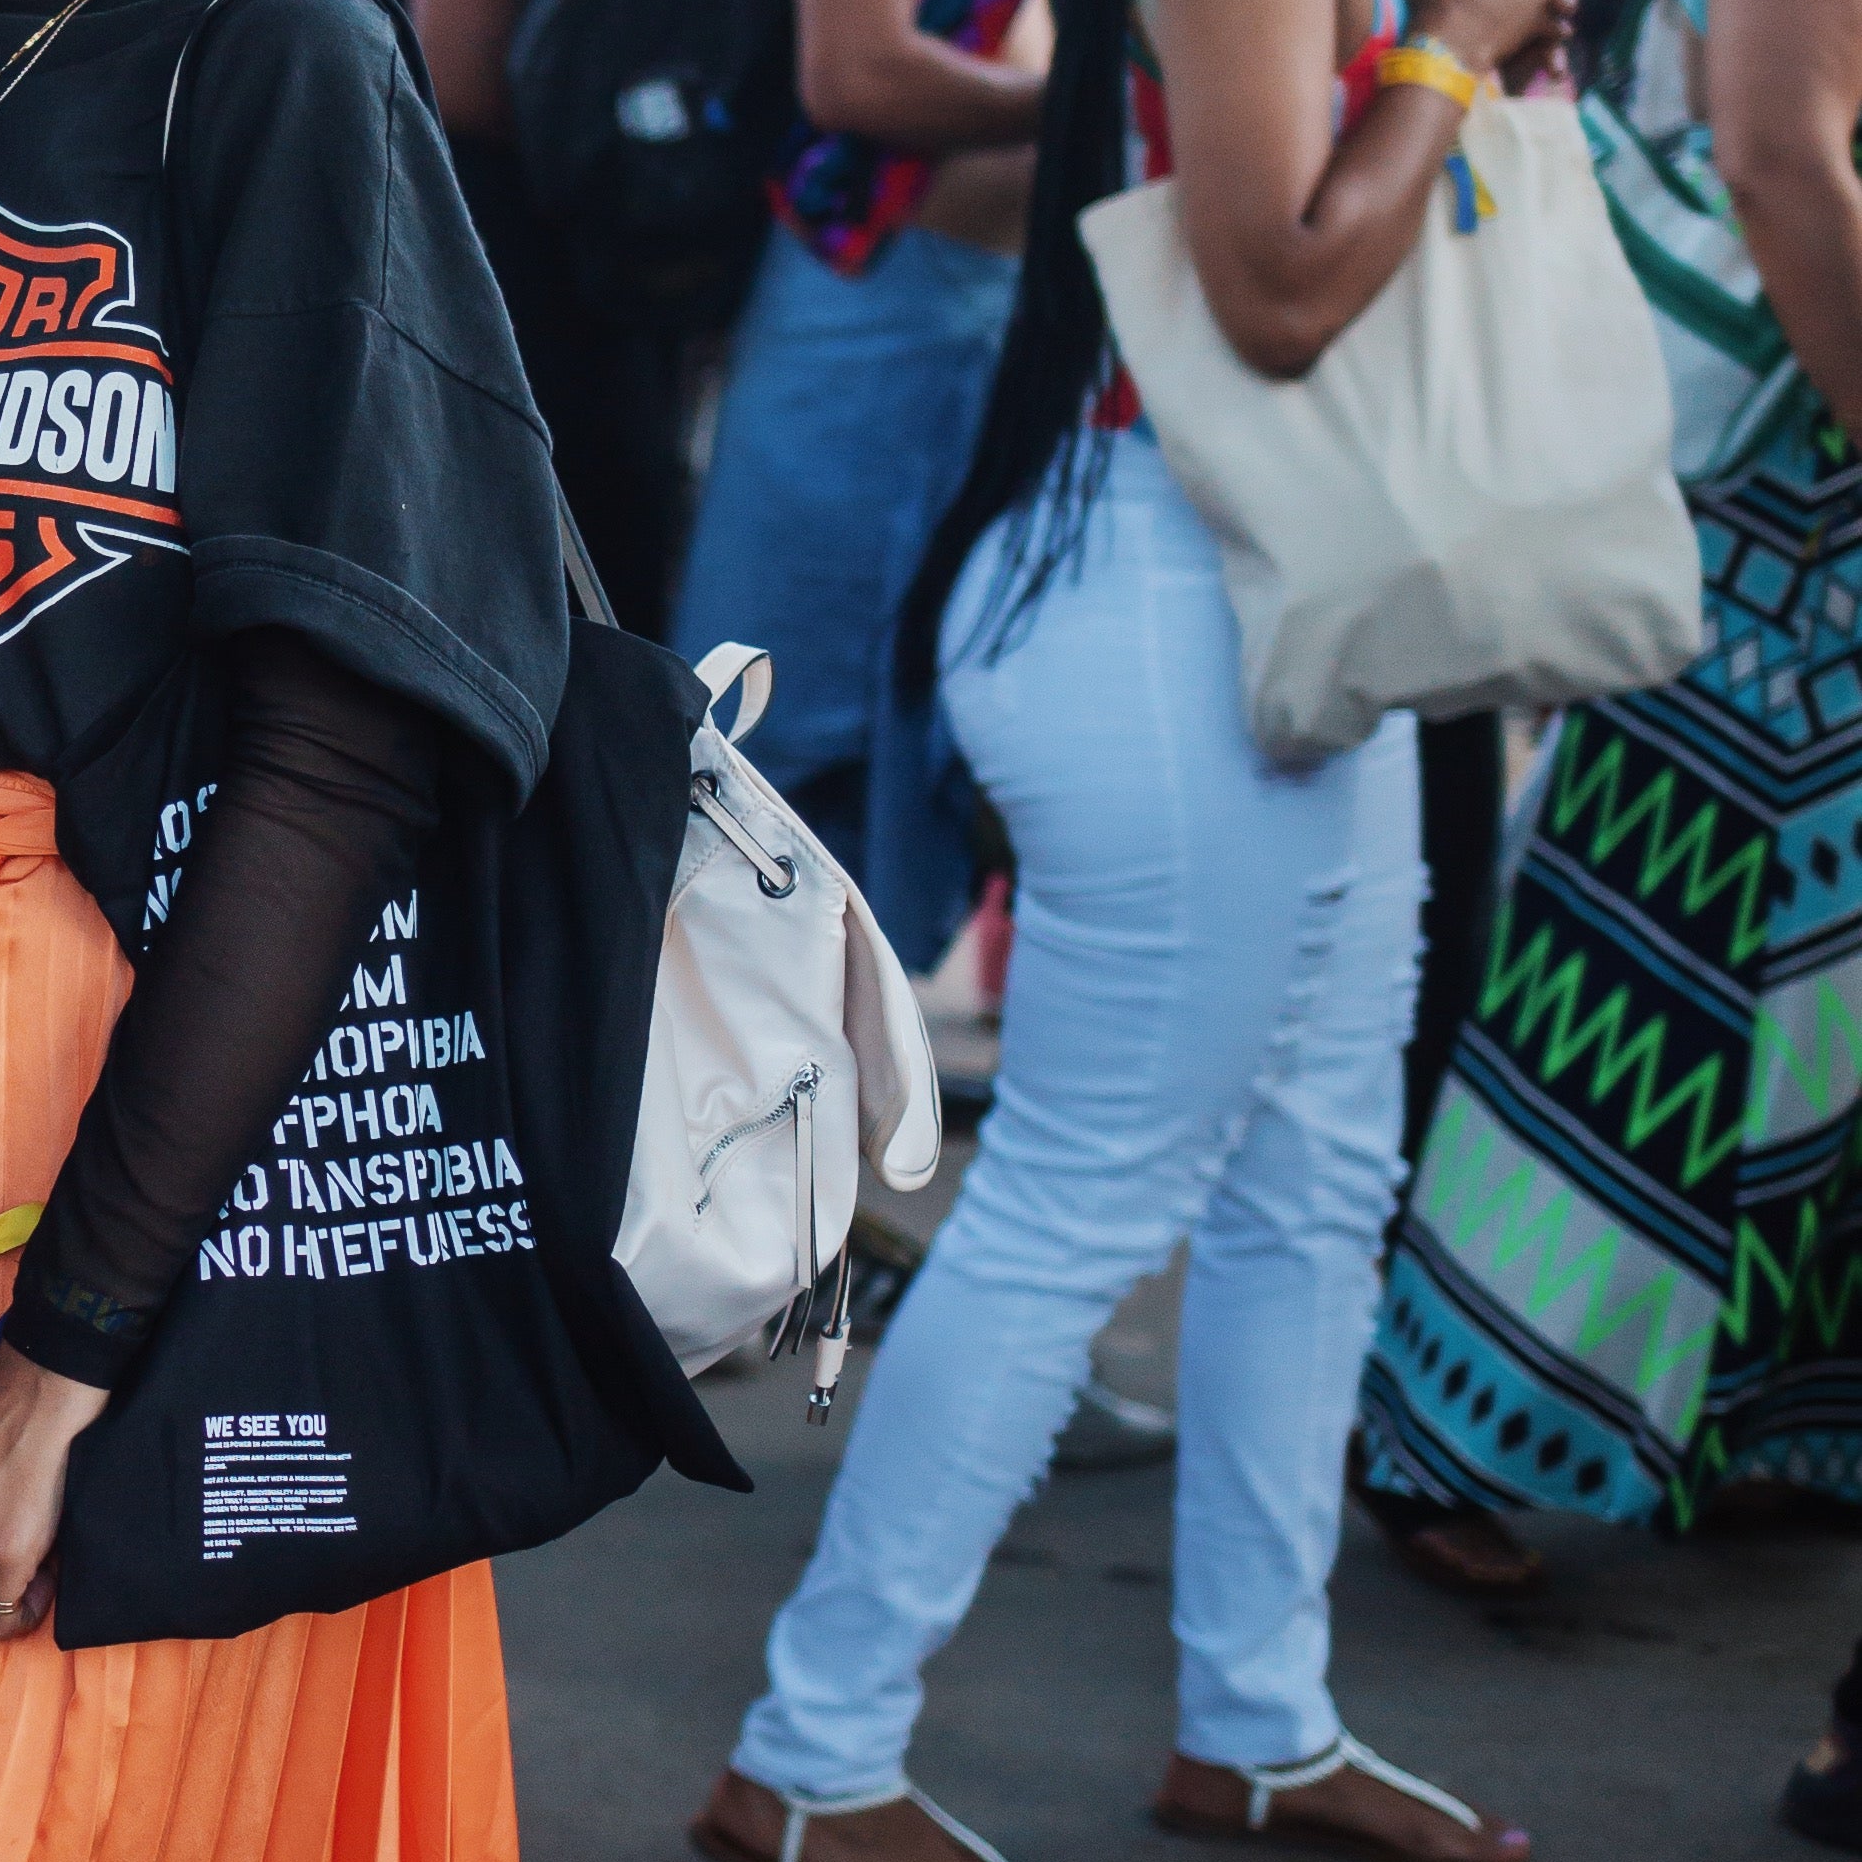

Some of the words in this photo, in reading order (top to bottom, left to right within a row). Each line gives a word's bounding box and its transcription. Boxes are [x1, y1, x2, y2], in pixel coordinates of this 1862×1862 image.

[199, 1225, 270, 1281] NO
[204, 1416, 235, 1438] WE
[238, 1415, 280, 1437] SEE
[285, 1414, 327, 1436] YOU
